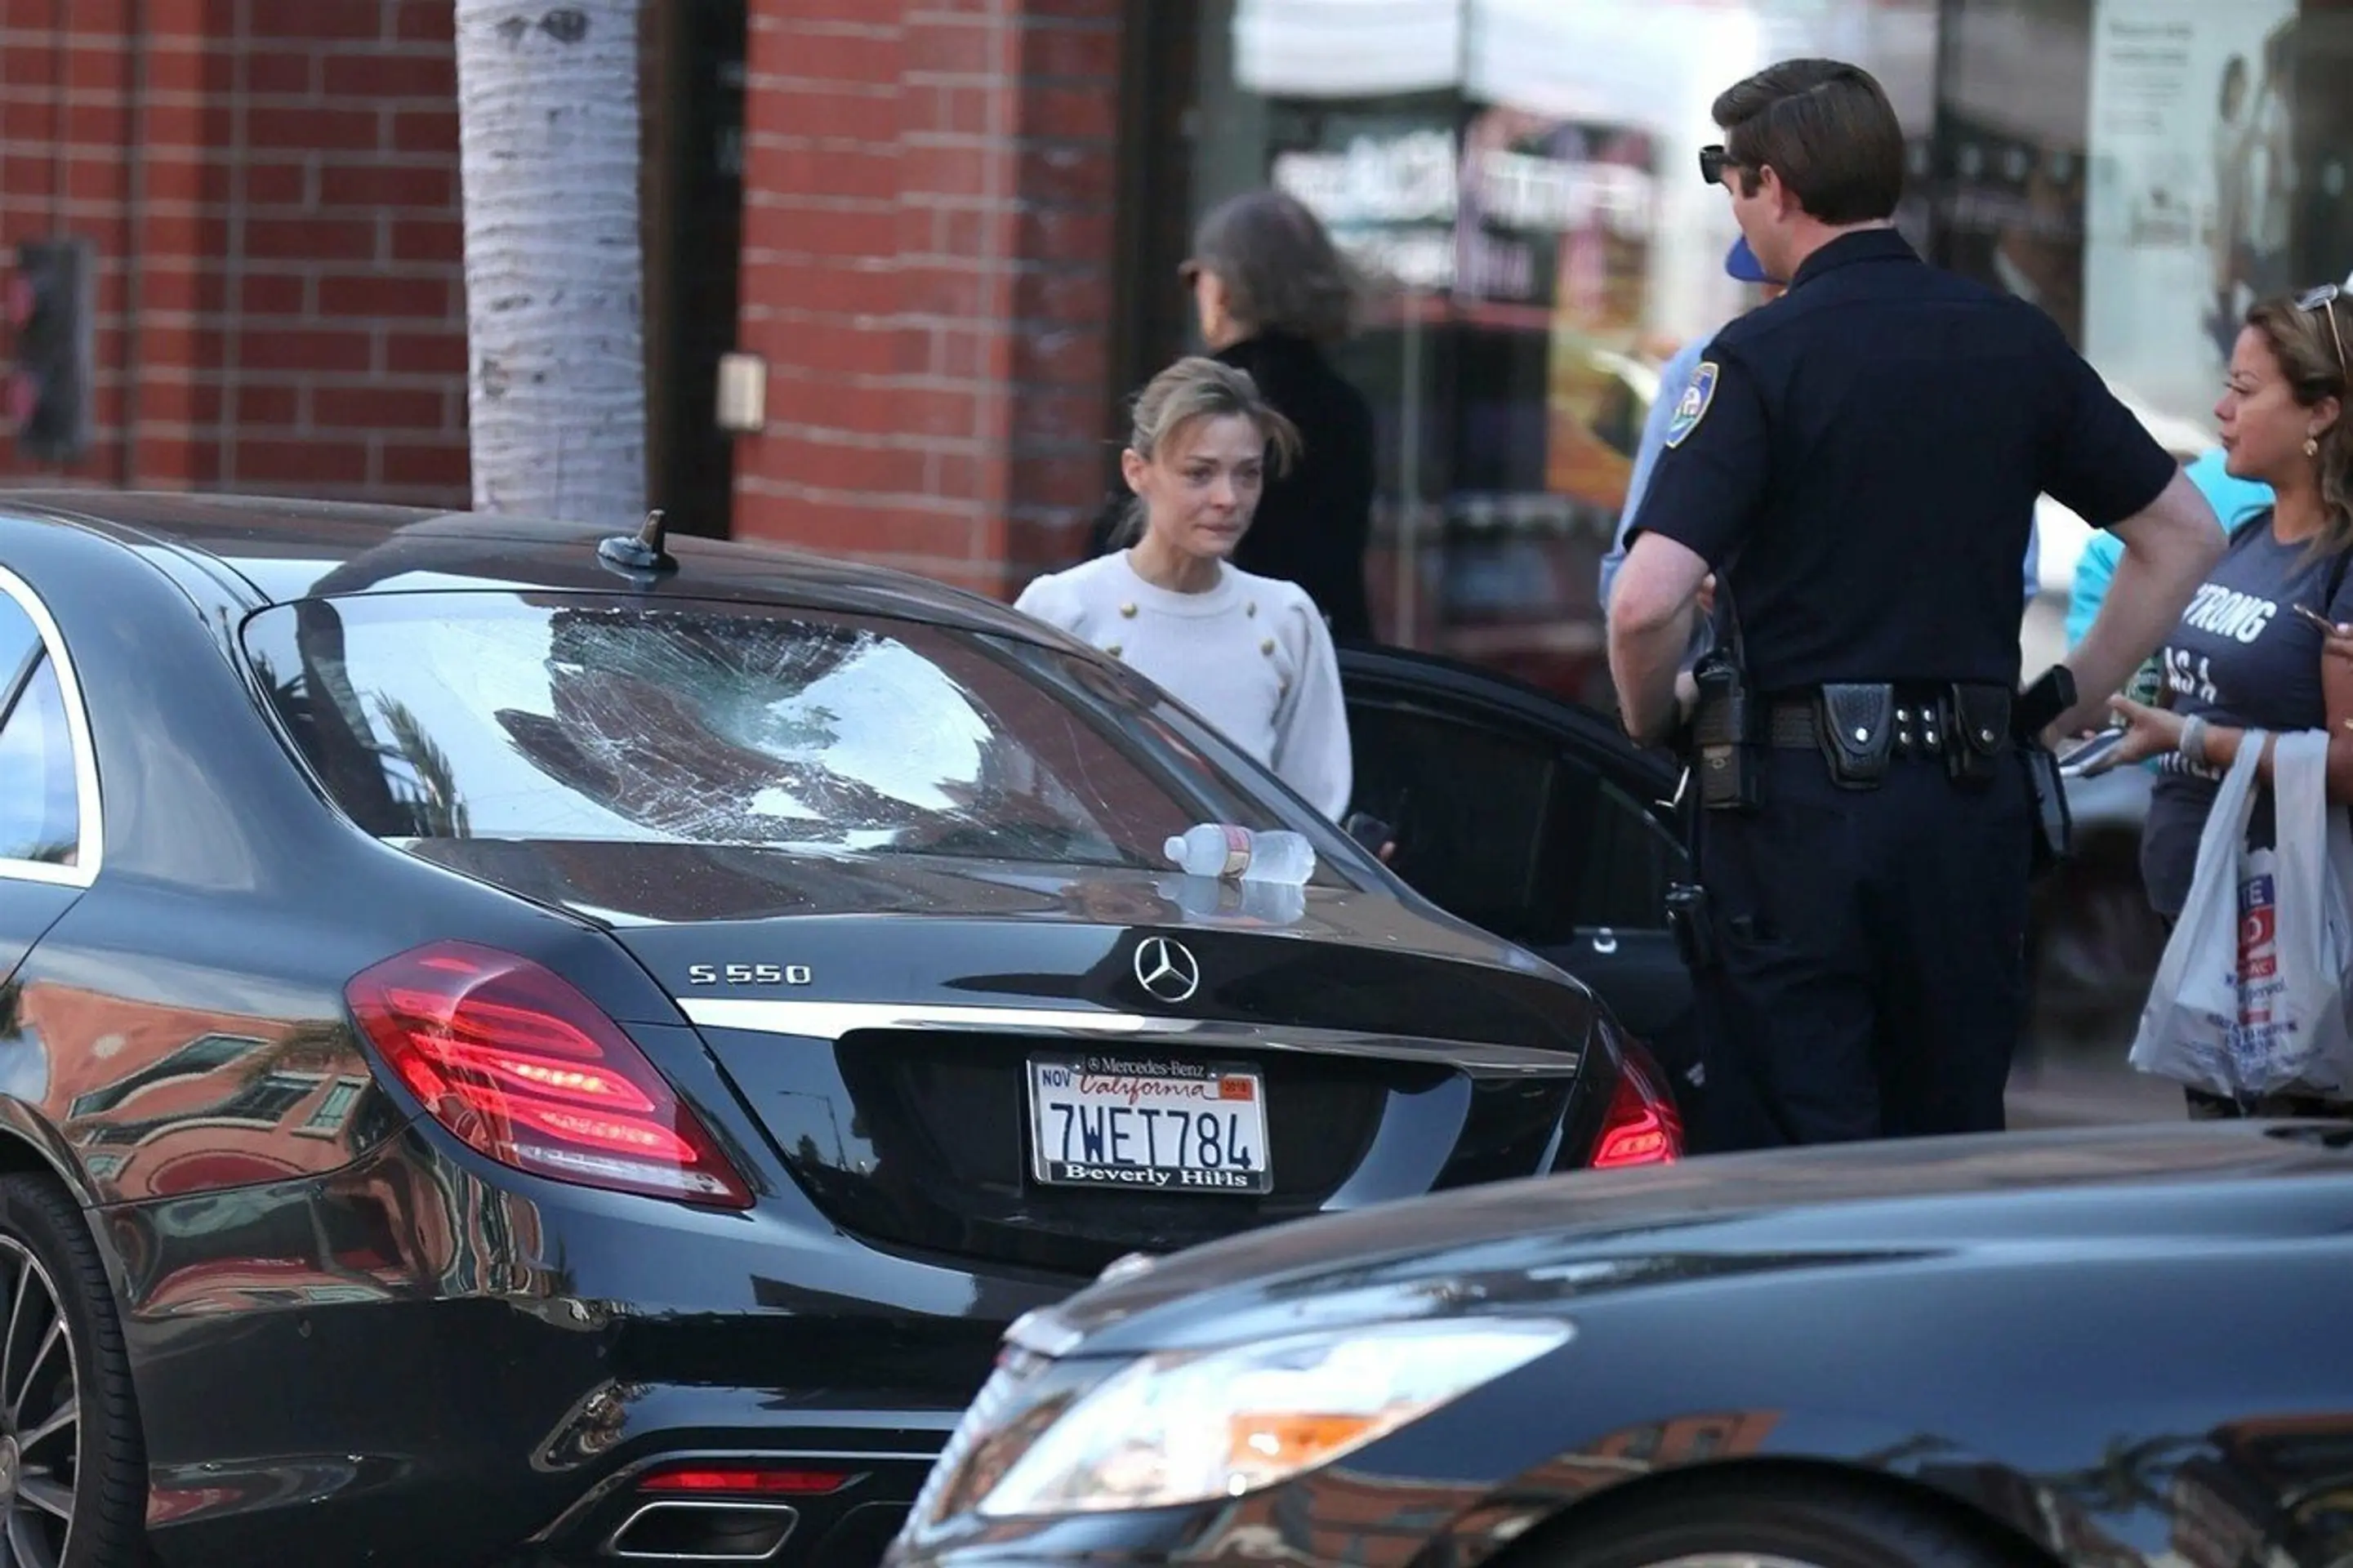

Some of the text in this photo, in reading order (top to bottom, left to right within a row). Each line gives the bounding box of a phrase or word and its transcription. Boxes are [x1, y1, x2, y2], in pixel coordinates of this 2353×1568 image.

[2181, 582, 2277, 643] TRONG
[689, 964, 812, 985] S 550
[1042, 1070, 1072, 1087] NOV
[1102, 1058, 1205, 1077] Mercedes-Benz
[1080, 1074, 1219, 1104] California
[1049, 1102, 1253, 1170] 7WET784
[1065, 1165, 1248, 1187] Beverly Hills
